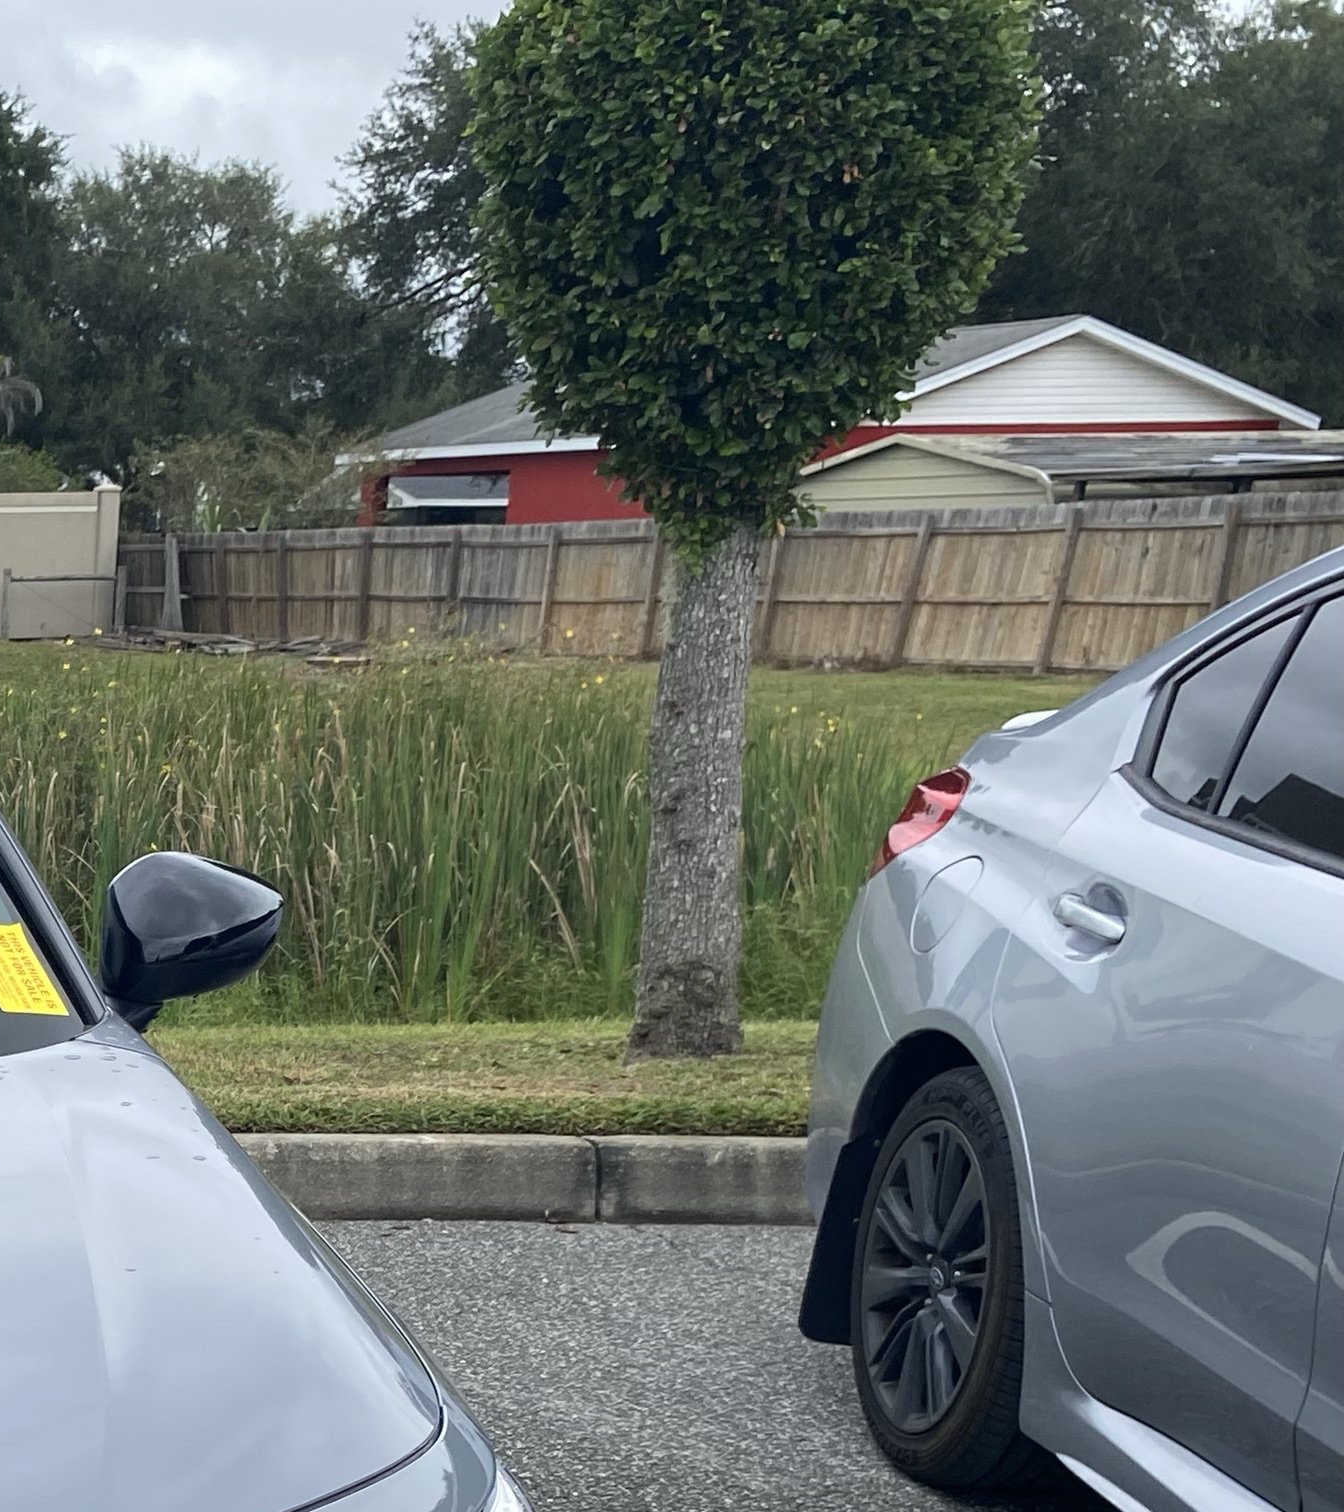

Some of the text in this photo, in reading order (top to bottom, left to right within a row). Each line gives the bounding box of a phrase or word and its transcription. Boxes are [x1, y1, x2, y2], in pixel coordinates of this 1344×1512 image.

[7, 932, 57, 1009] THIS VEHICLE IS
[9, 957, 26, 976] FOR
[22, 978, 41, 1003] SALE
